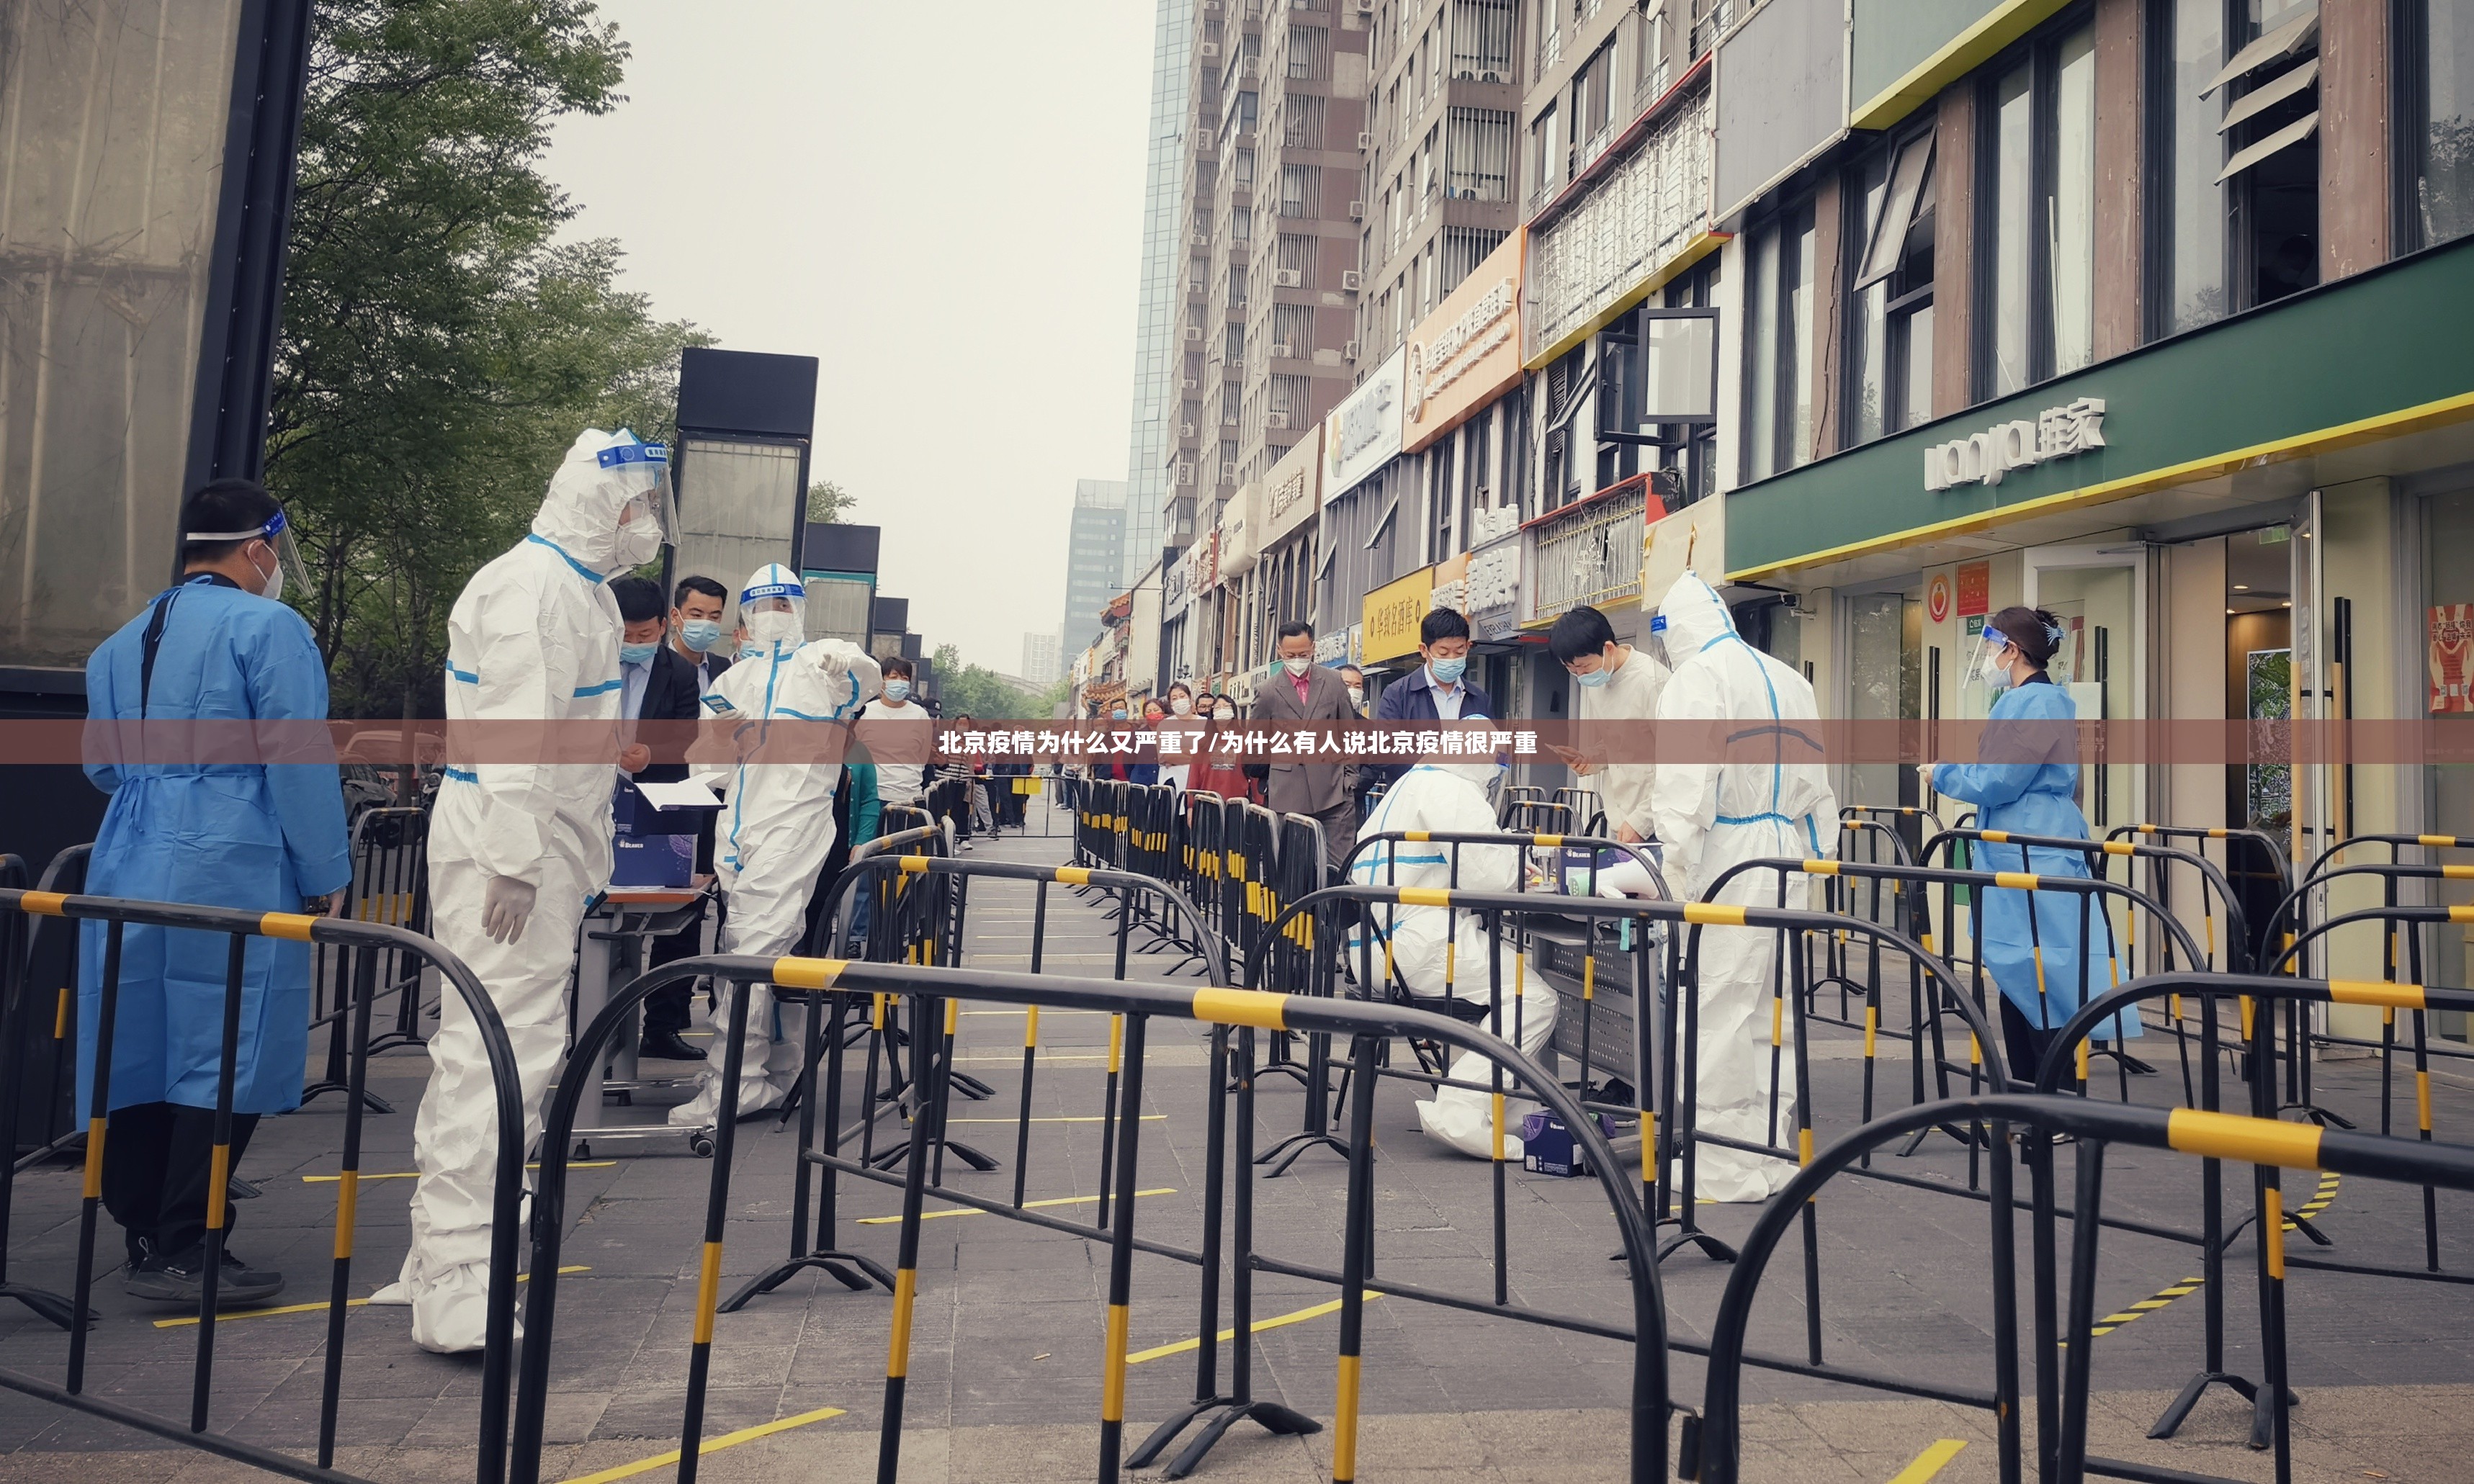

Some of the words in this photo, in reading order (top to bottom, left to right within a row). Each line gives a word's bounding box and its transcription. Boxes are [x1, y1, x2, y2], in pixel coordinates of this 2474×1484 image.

[1376, 596, 1412, 641] 华致名酒库
